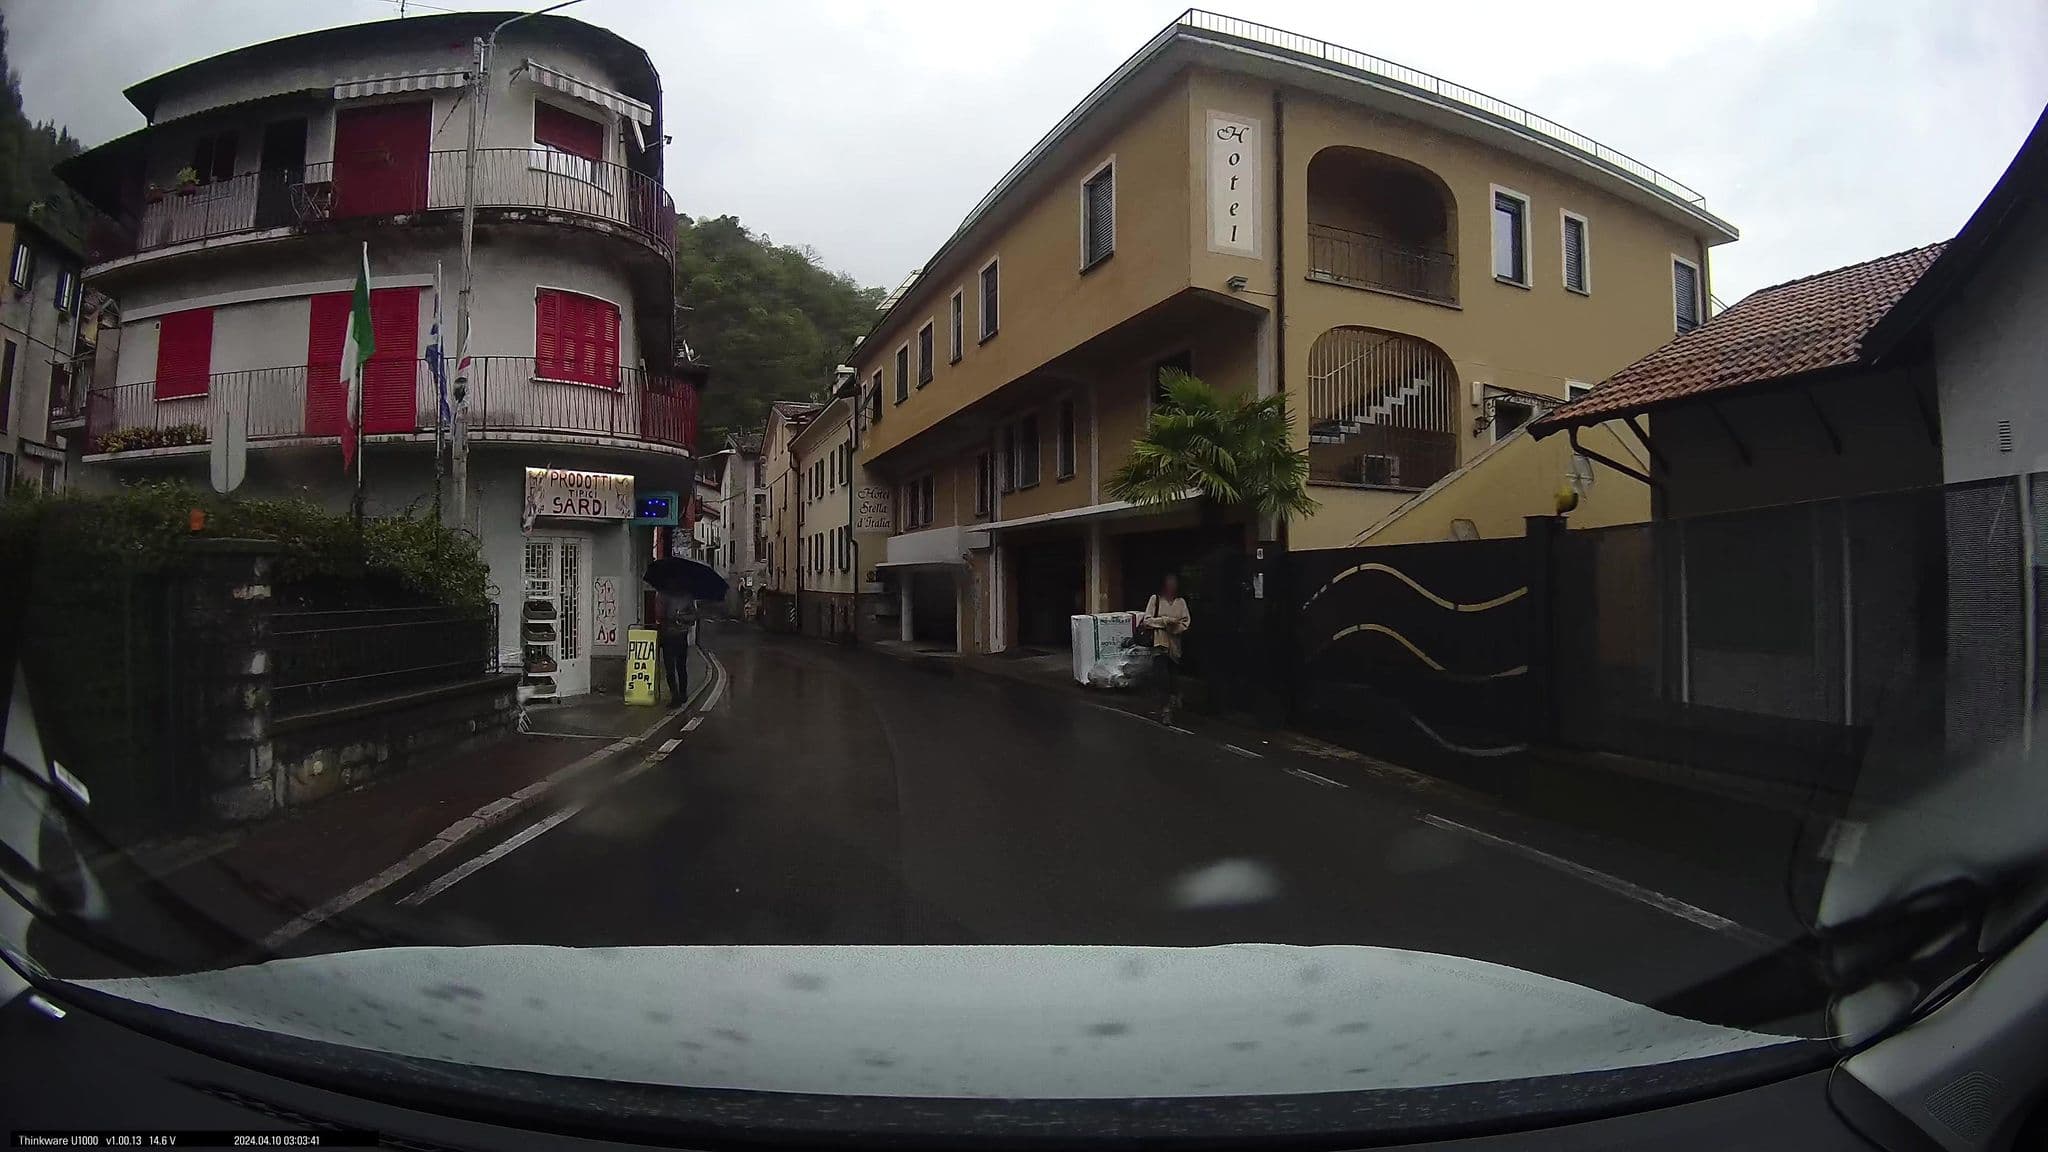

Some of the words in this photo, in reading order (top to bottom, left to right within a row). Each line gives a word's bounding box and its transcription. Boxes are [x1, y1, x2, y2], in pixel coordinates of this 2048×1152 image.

[1216, 125, 1250, 242] Hotel
[550, 471, 612, 490] PRODOTTI
[568, 489, 598, 499] TIPICI
[857, 487, 890, 500] Hotel
[552, 497, 607, 516] SARDI
[859, 501, 887, 514] Stella
[857, 516, 891, 528] d'Italia
[628, 641, 655, 660] PIZZA
[634, 662, 647, 670] DA
